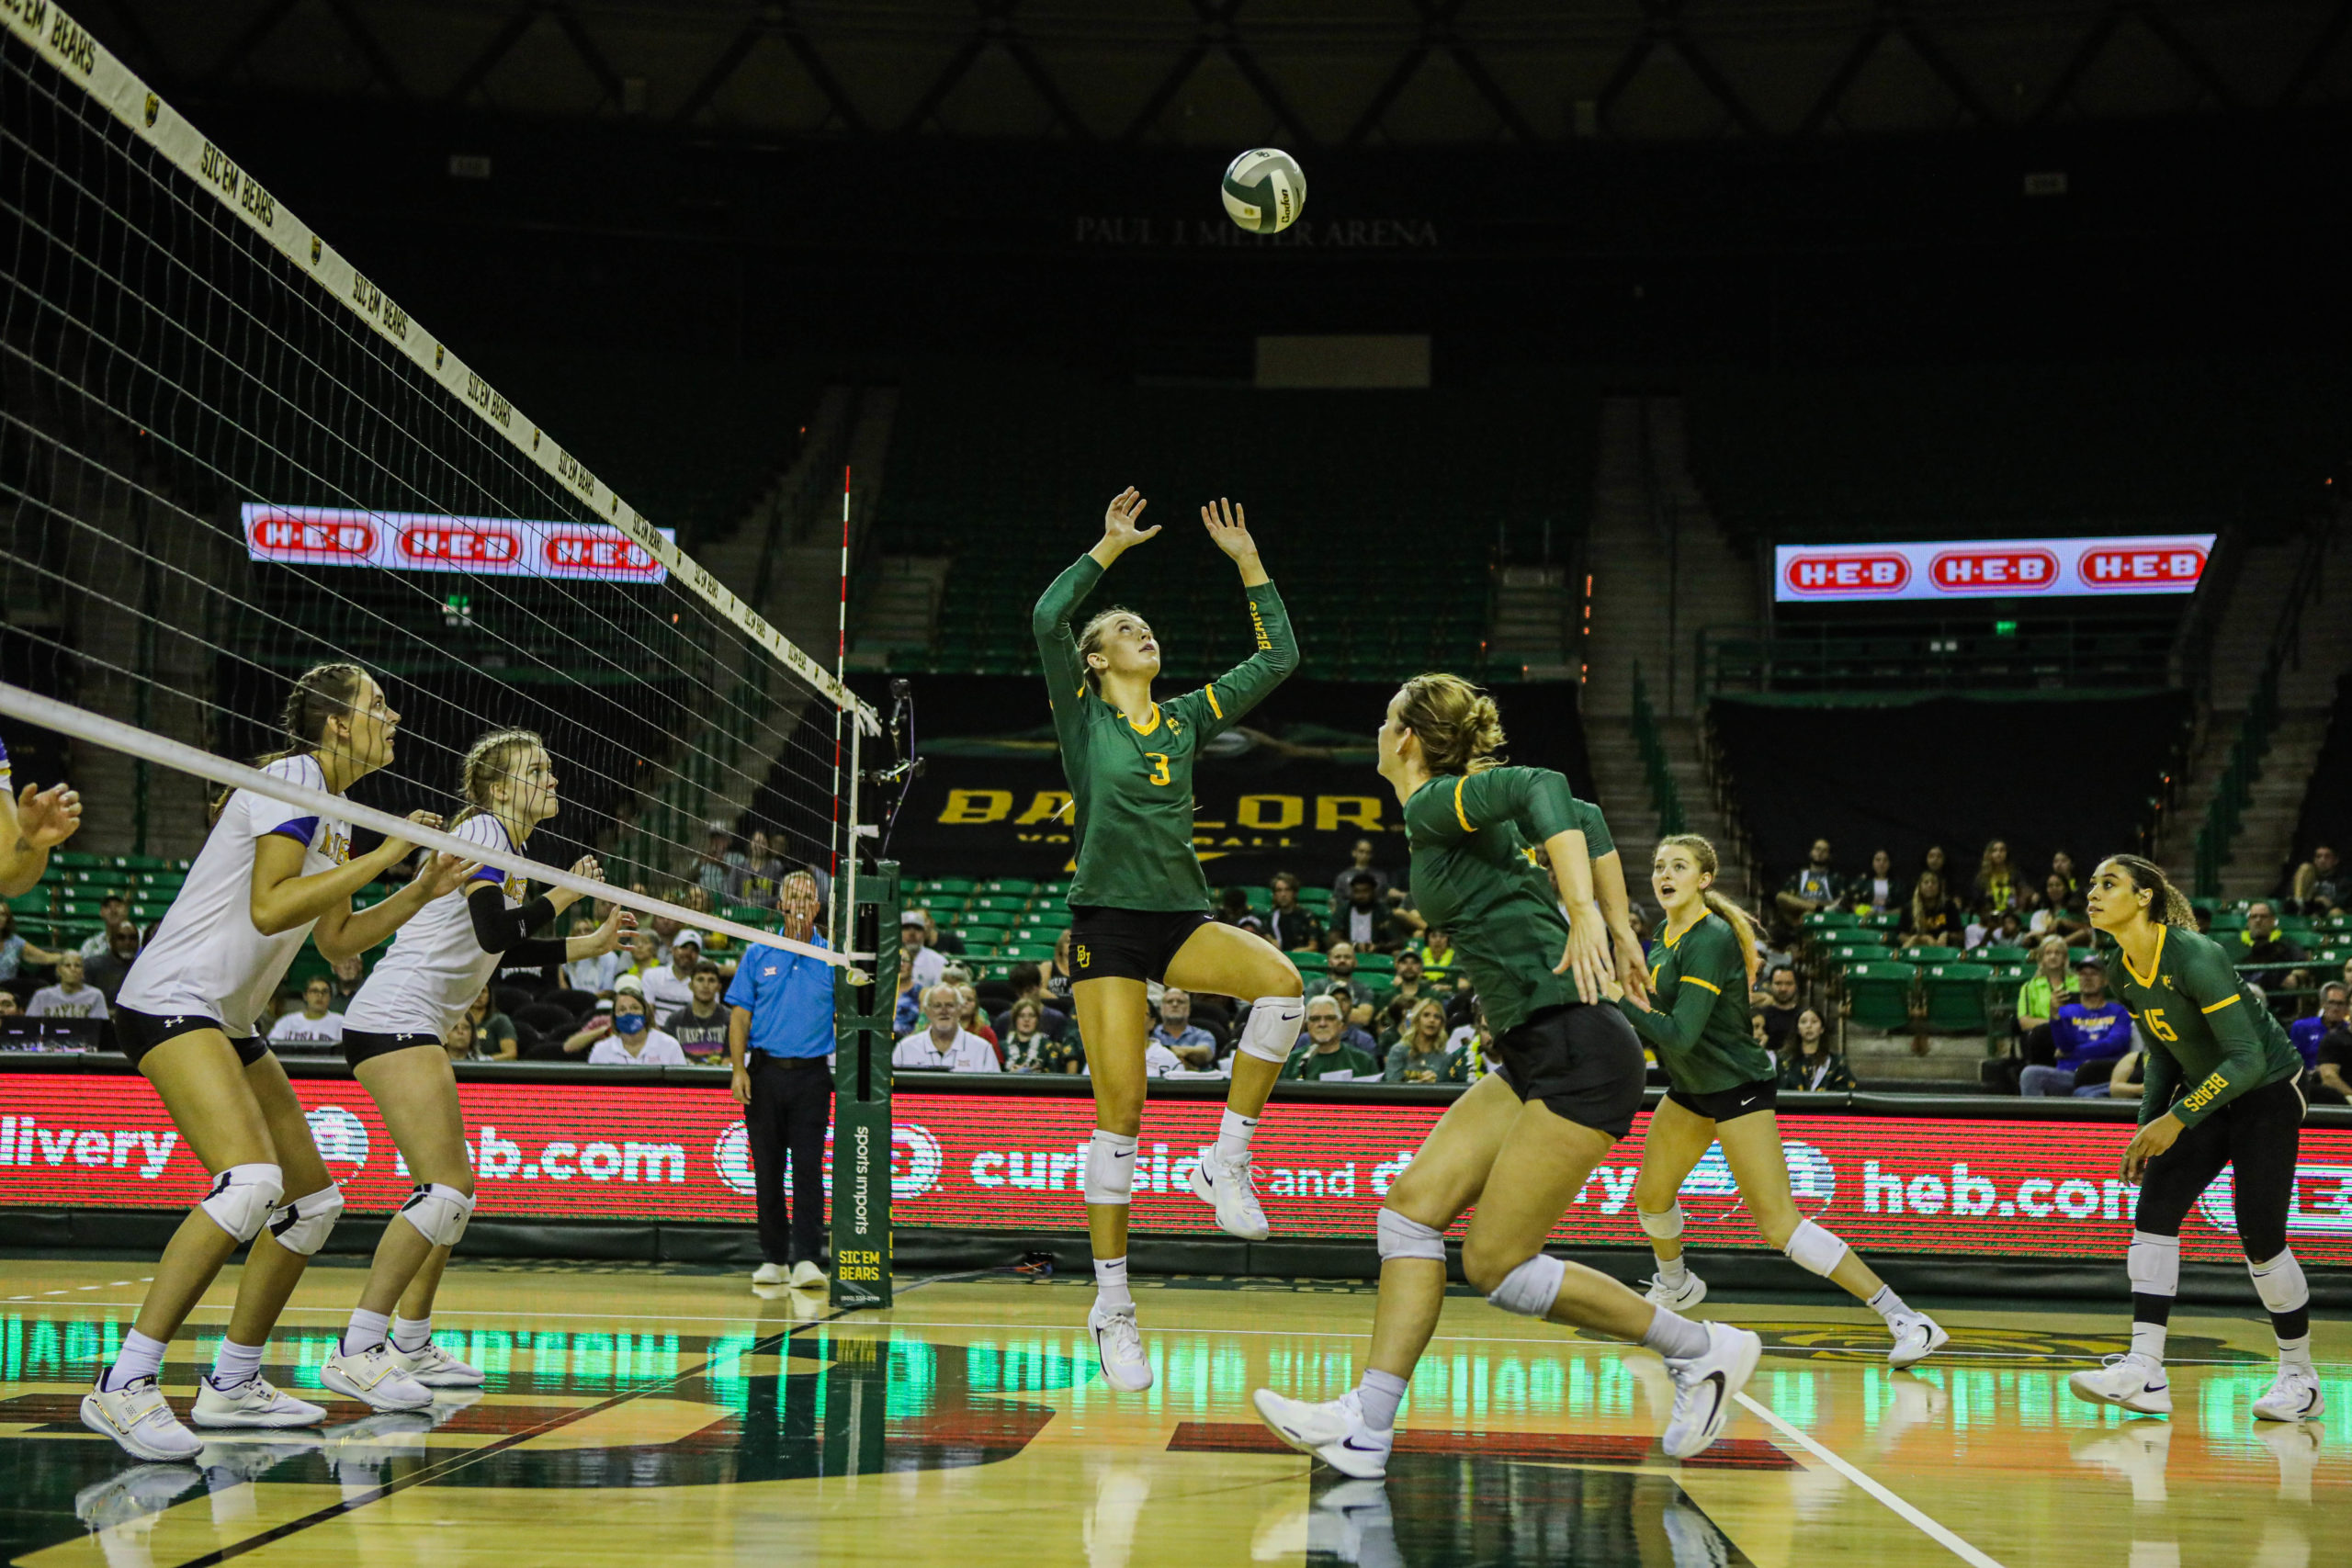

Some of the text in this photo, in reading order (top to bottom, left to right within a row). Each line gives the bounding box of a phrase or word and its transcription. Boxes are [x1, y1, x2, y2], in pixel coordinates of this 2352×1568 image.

[51, 12, 96, 75] BEARS
[242, 175, 275, 228] BEARS
[1076, 217, 1154, 244] PAUL
[1325, 220, 1438, 246] ARENA
[383, 298, 408, 341] BEARS
[491, 392, 512, 428] BEARS
[578, 467, 594, 497] BEARS
[1145, 752, 1170, 786] 3
[937, 788, 1385, 830] BAOR
[1077, 944, 1091, 968] BU
[2144, 1009, 2178, 1042] 15
[2184, 1072, 2229, 1112] BEARS
[0, 1116, 177, 1179] livery
[395, 1126, 685, 1183] b.com
[853, 1125, 869, 1235] sports imports
[1269, 1161, 1355, 1198] and
[839, 1266, 880, 1280] BEARS
